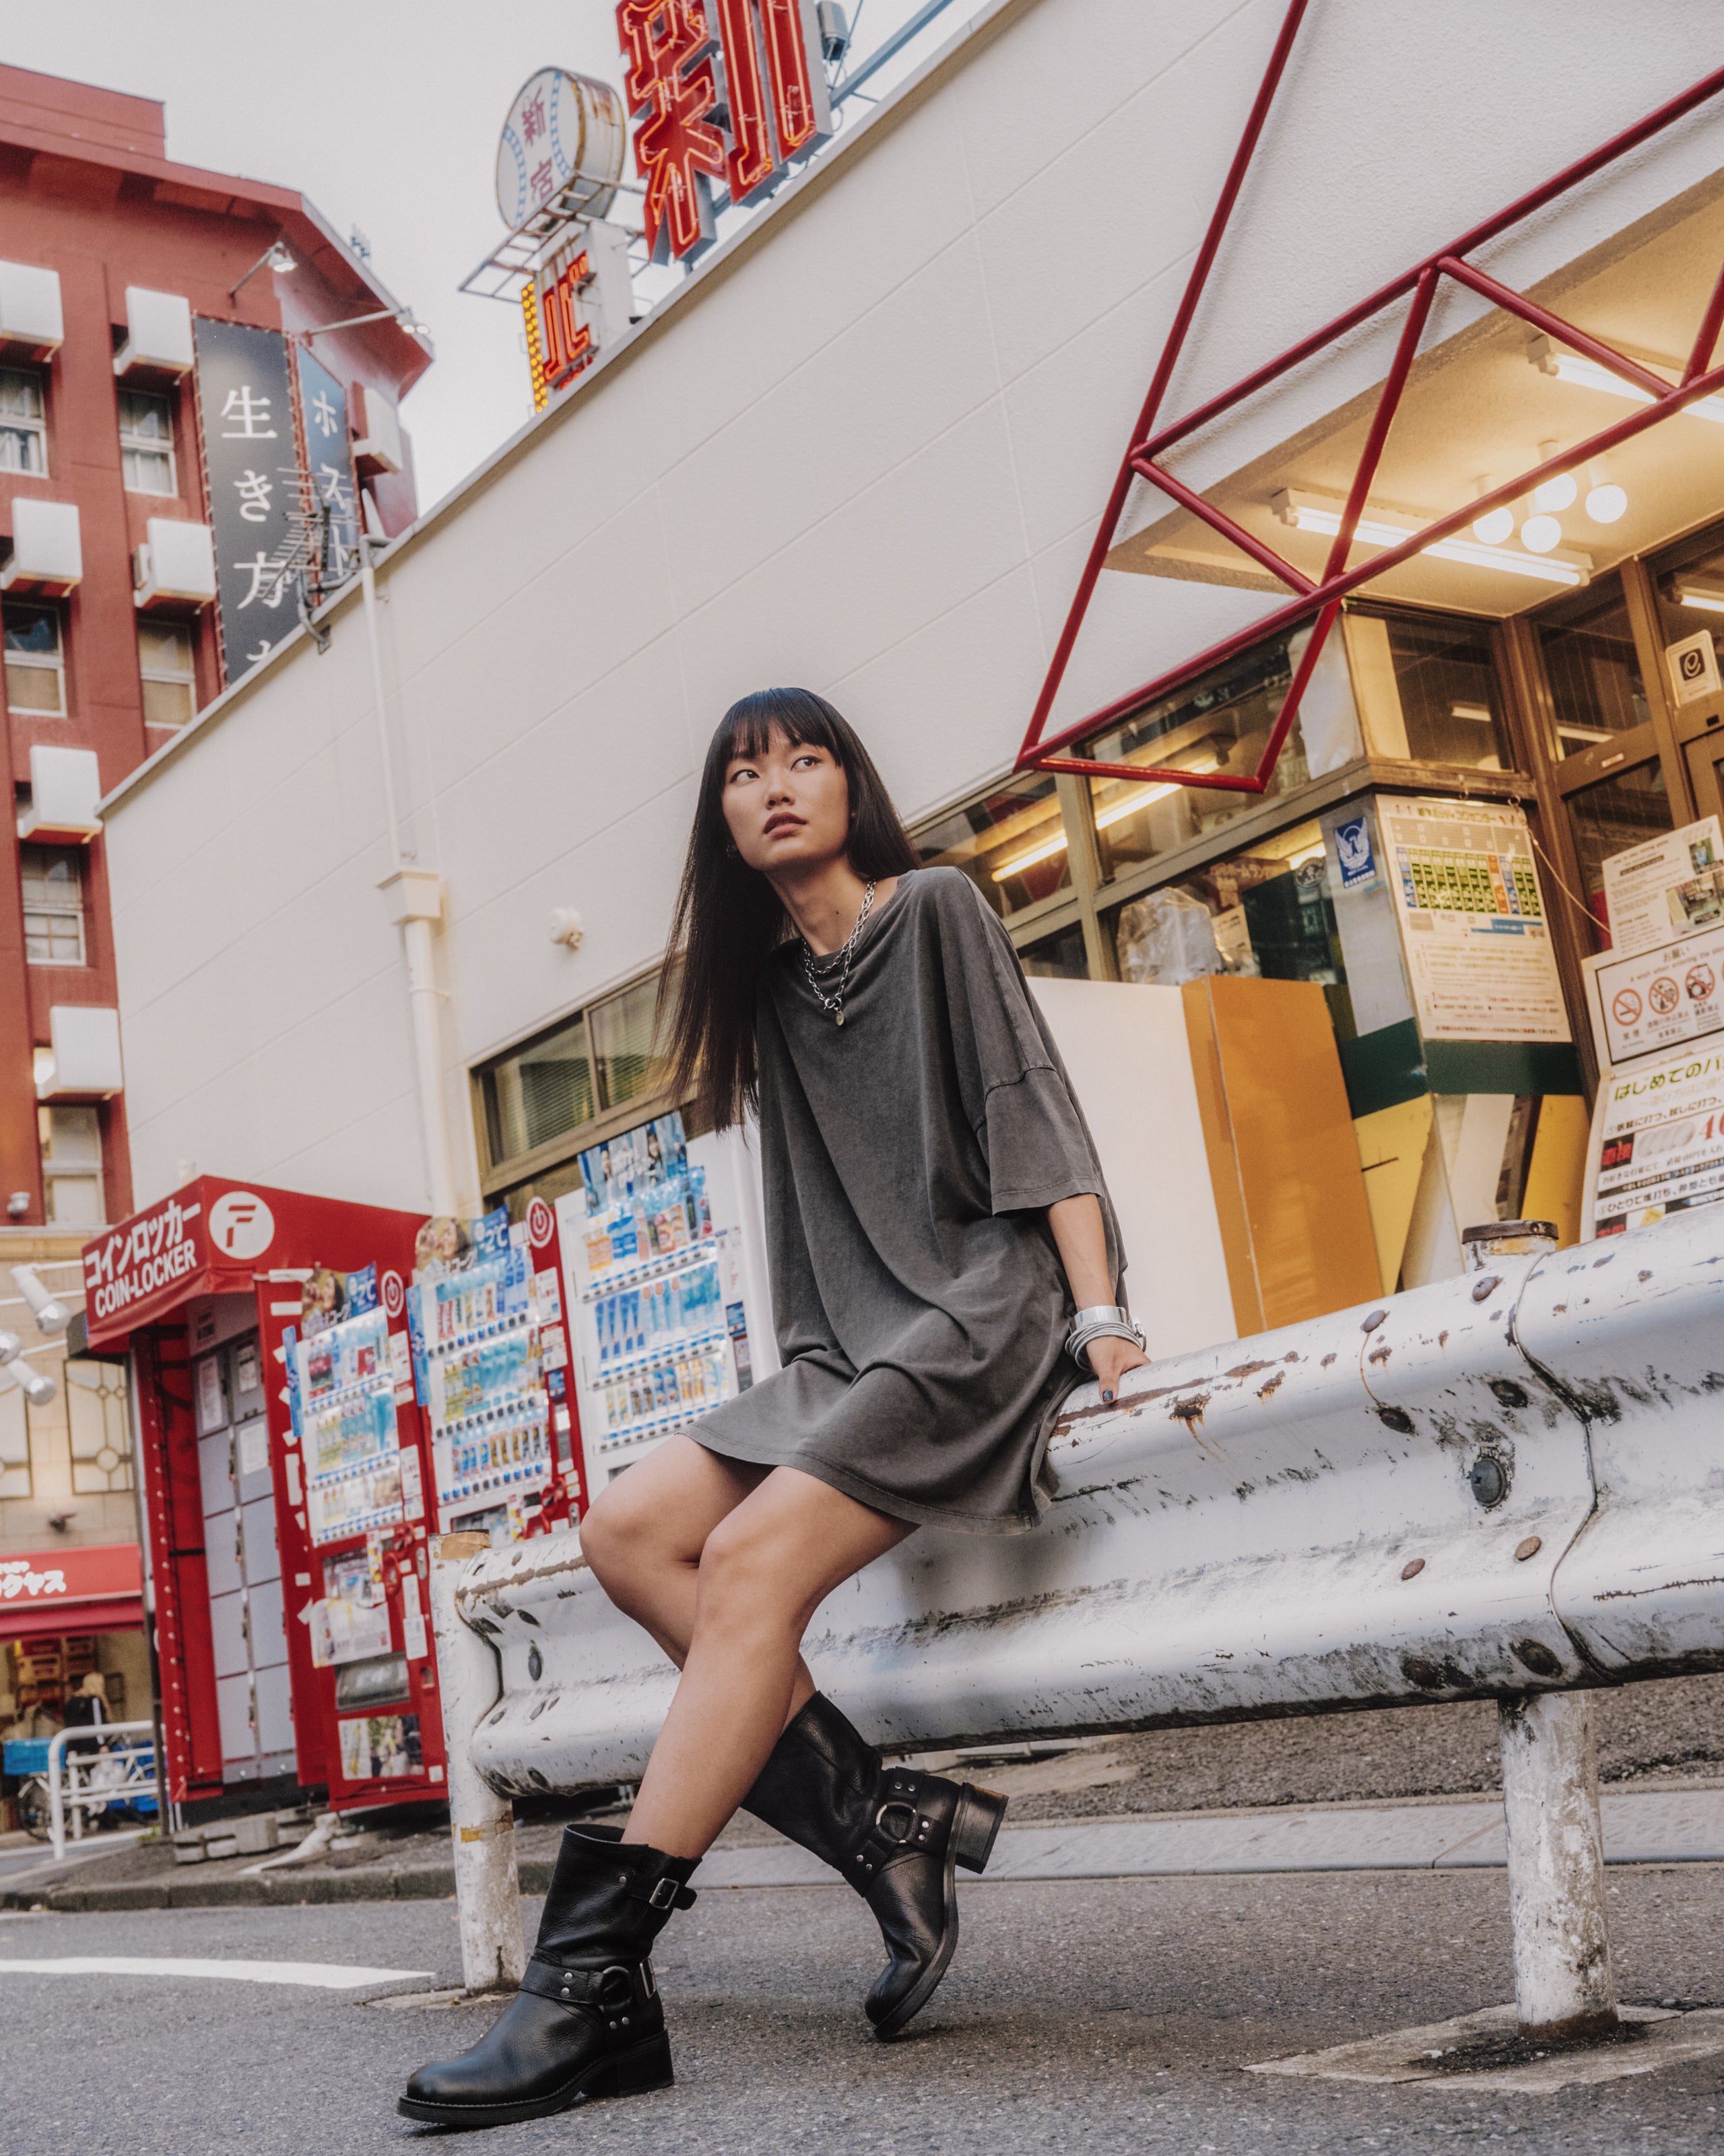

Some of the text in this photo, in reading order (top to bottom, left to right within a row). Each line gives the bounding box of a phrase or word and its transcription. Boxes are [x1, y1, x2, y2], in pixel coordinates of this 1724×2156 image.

[521, 86, 555, 201] 新宿
[1614, 1054, 1724, 1102] はじめてのバ
[84, 1199, 201, 1289] コインロッカー
[95, 1238, 197, 1318] COIN-LOCKER
[0, 1570, 67, 1598] クヤス
